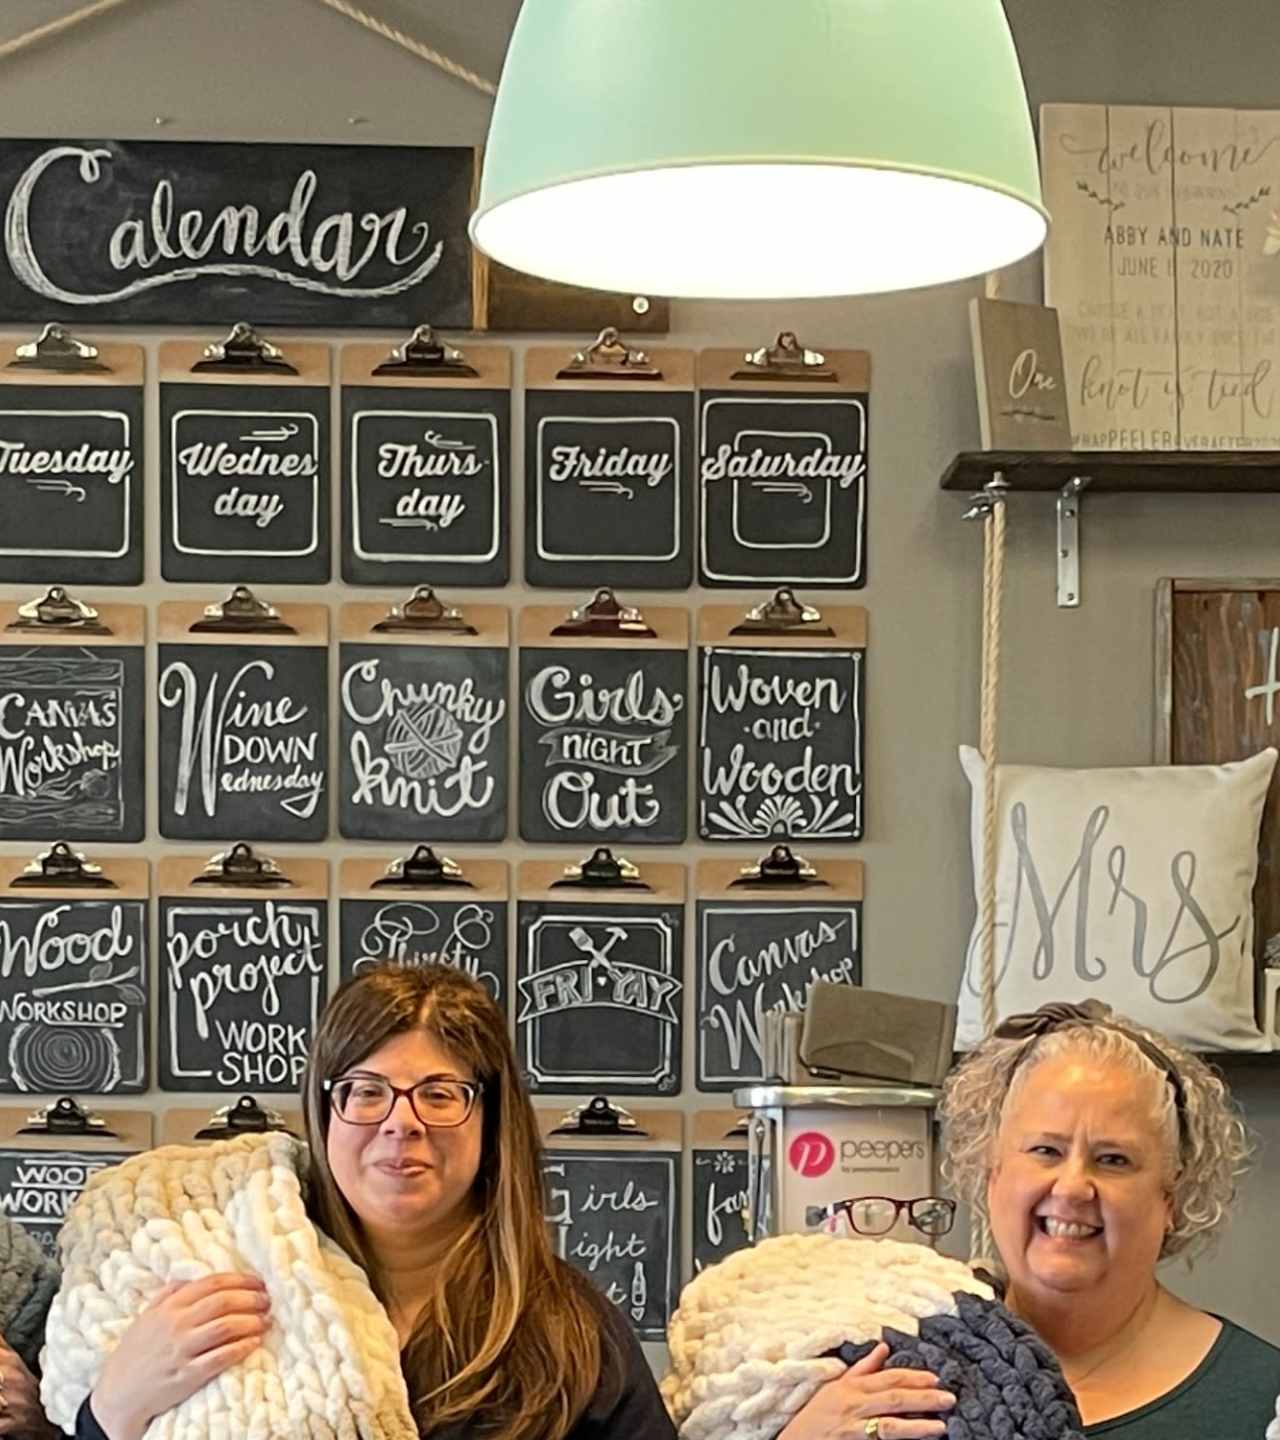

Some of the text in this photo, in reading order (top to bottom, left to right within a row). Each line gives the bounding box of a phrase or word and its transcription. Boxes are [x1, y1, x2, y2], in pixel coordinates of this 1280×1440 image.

[3, 146, 444, 305] Calendar
[1104, 224, 1245, 249] ABBY AND NATE
[1117, 255, 1159, 279] JUNE
[1190, 257, 1234, 280] 2020
[178, 442, 319, 477] Wednes
[548, 446, 673, 487] Friday
[700, 444, 867, 489] Saturday
[213, 486, 285, 528] day
[395, 486, 466, 528] day
[341, 658, 505, 755] Chunky
[524, 664, 684, 727] Girls
[710, 664, 847, 714] Woven
[223, 732, 318, 766] DOWN
[703, 743, 862, 798] Wooden
[541, 770, 661, 831] Out
[167, 900, 303, 990] porch
[708, 917, 848, 996] Canvas
[189, 925, 324, 1041] project
[216, 1019, 309, 1056] WORK
[216, 1051, 310, 1087] SHOP
[840, 1139, 926, 1163] peepers
